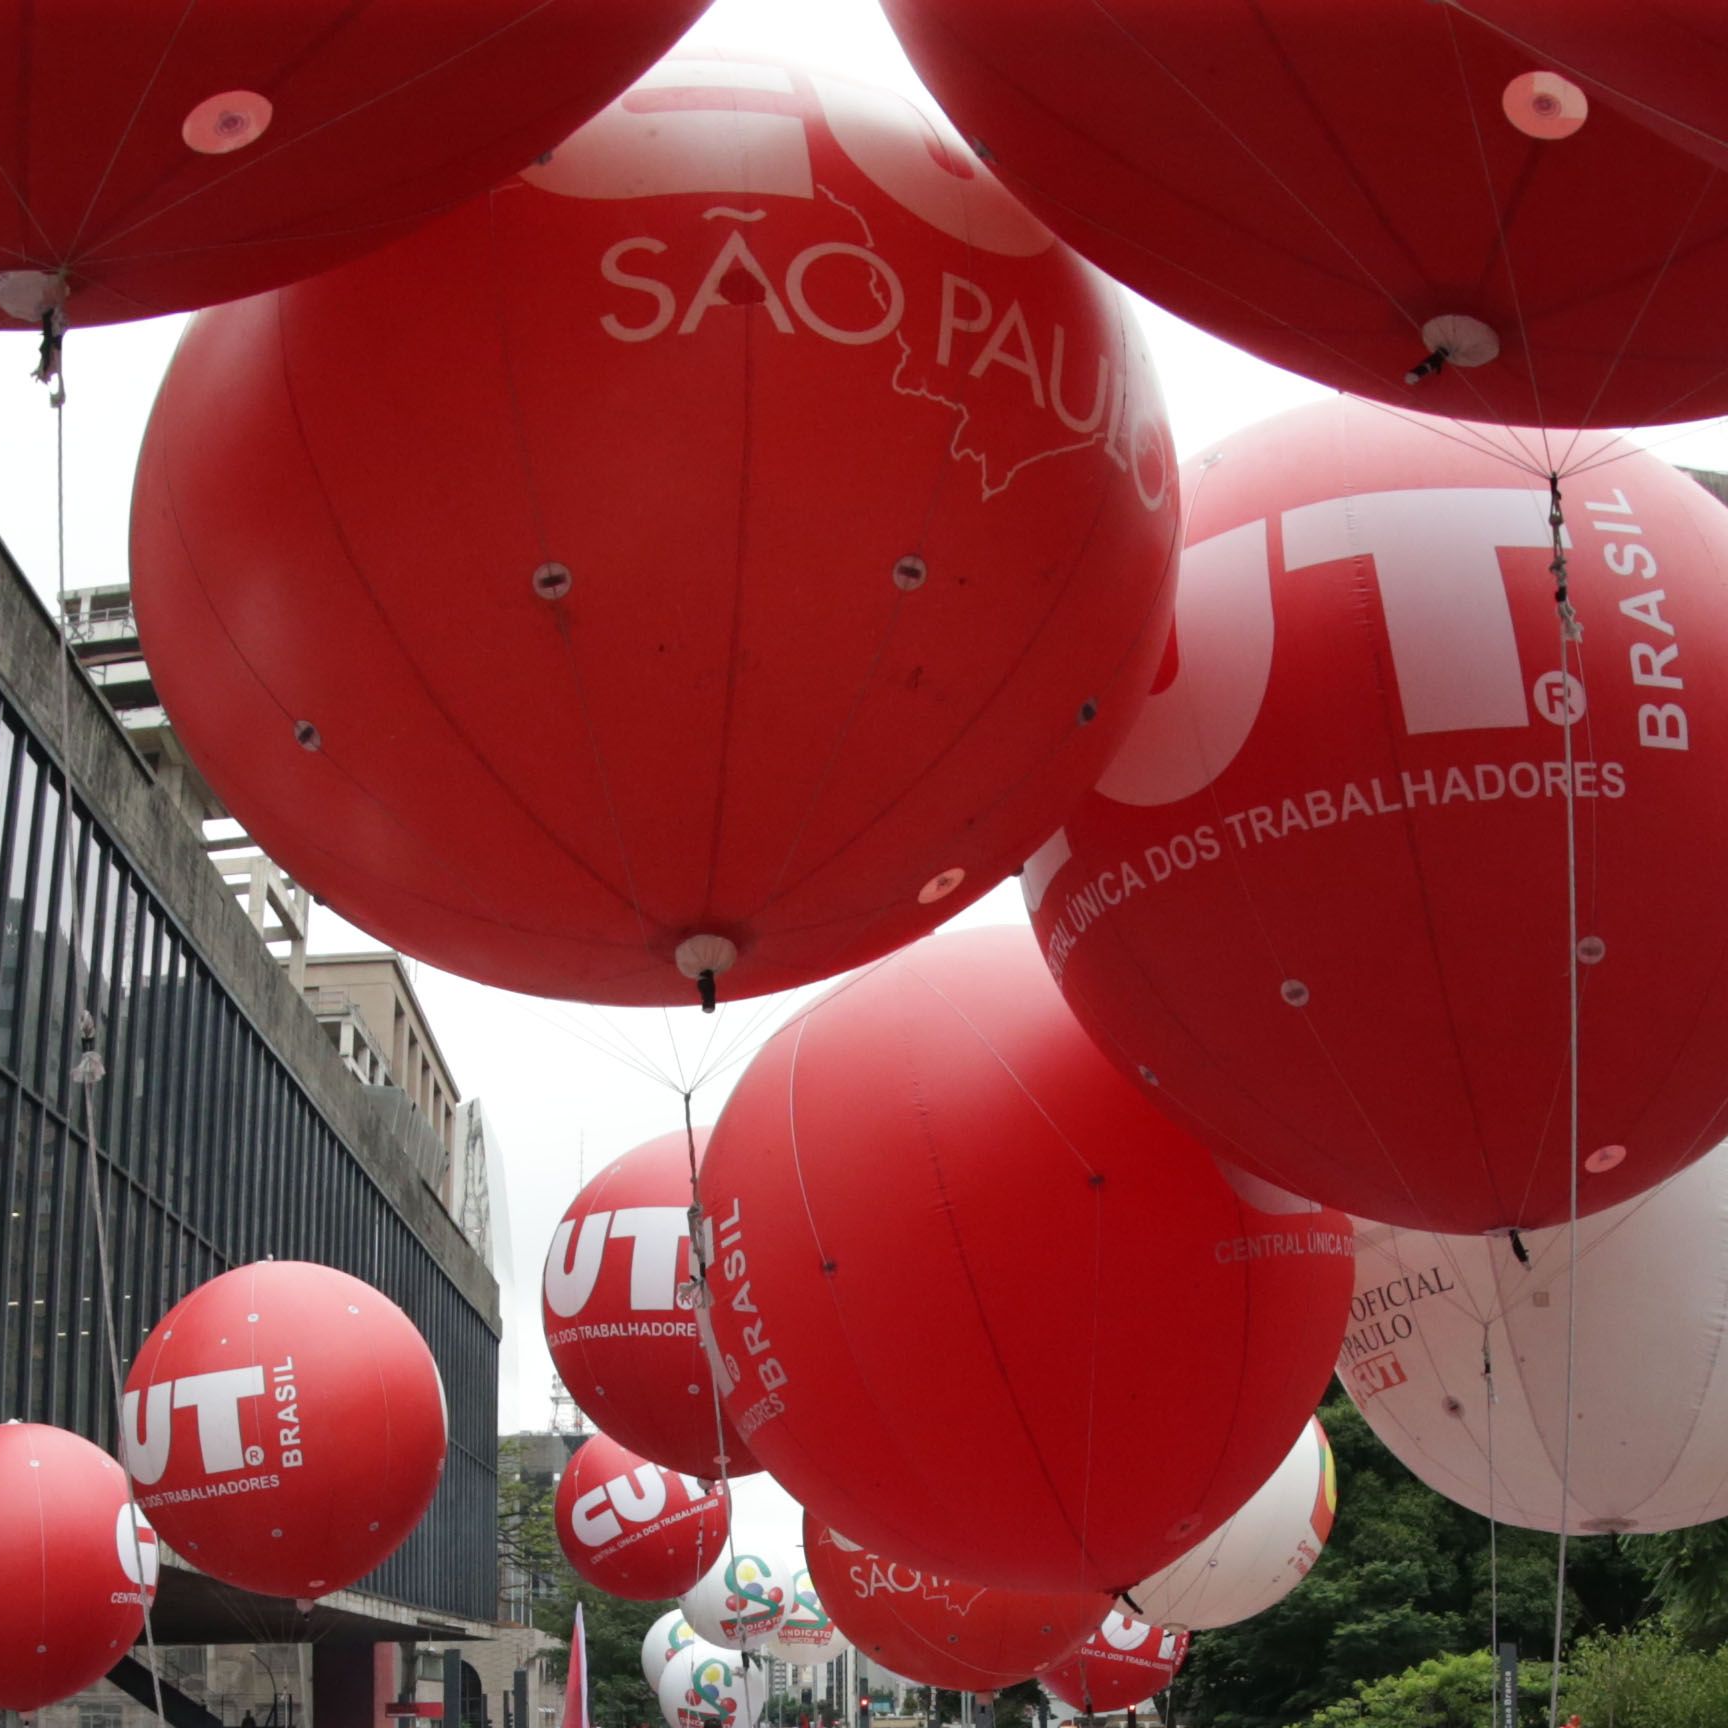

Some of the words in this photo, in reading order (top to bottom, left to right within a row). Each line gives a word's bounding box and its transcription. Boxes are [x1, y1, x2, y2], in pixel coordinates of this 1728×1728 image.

[600, 207, 904, 344] SÃO
[936, 272, 1171, 512] PAULO
[1094, 486, 1574, 810] UT
[1585, 486, 1689, 751] BRASIL
[1068, 860, 1147, 932] ÚNICA
[1149, 823, 1222, 883] DOS
[1225, 760, 1626, 853] TRABALHADORES
[720, 1198, 788, 1390] BRASIL
[1214, 1231, 1304, 1263] CENTRAL
[1352, 1266, 1455, 1323] OFICIAL
[578, 1321, 697, 1342] TRABALHADORE
[272, 1356, 303, 1469] BRASIL
[163, 1474, 279, 1505] TRABALHADORES
[779, 1629, 831, 1642] SINDICATO
